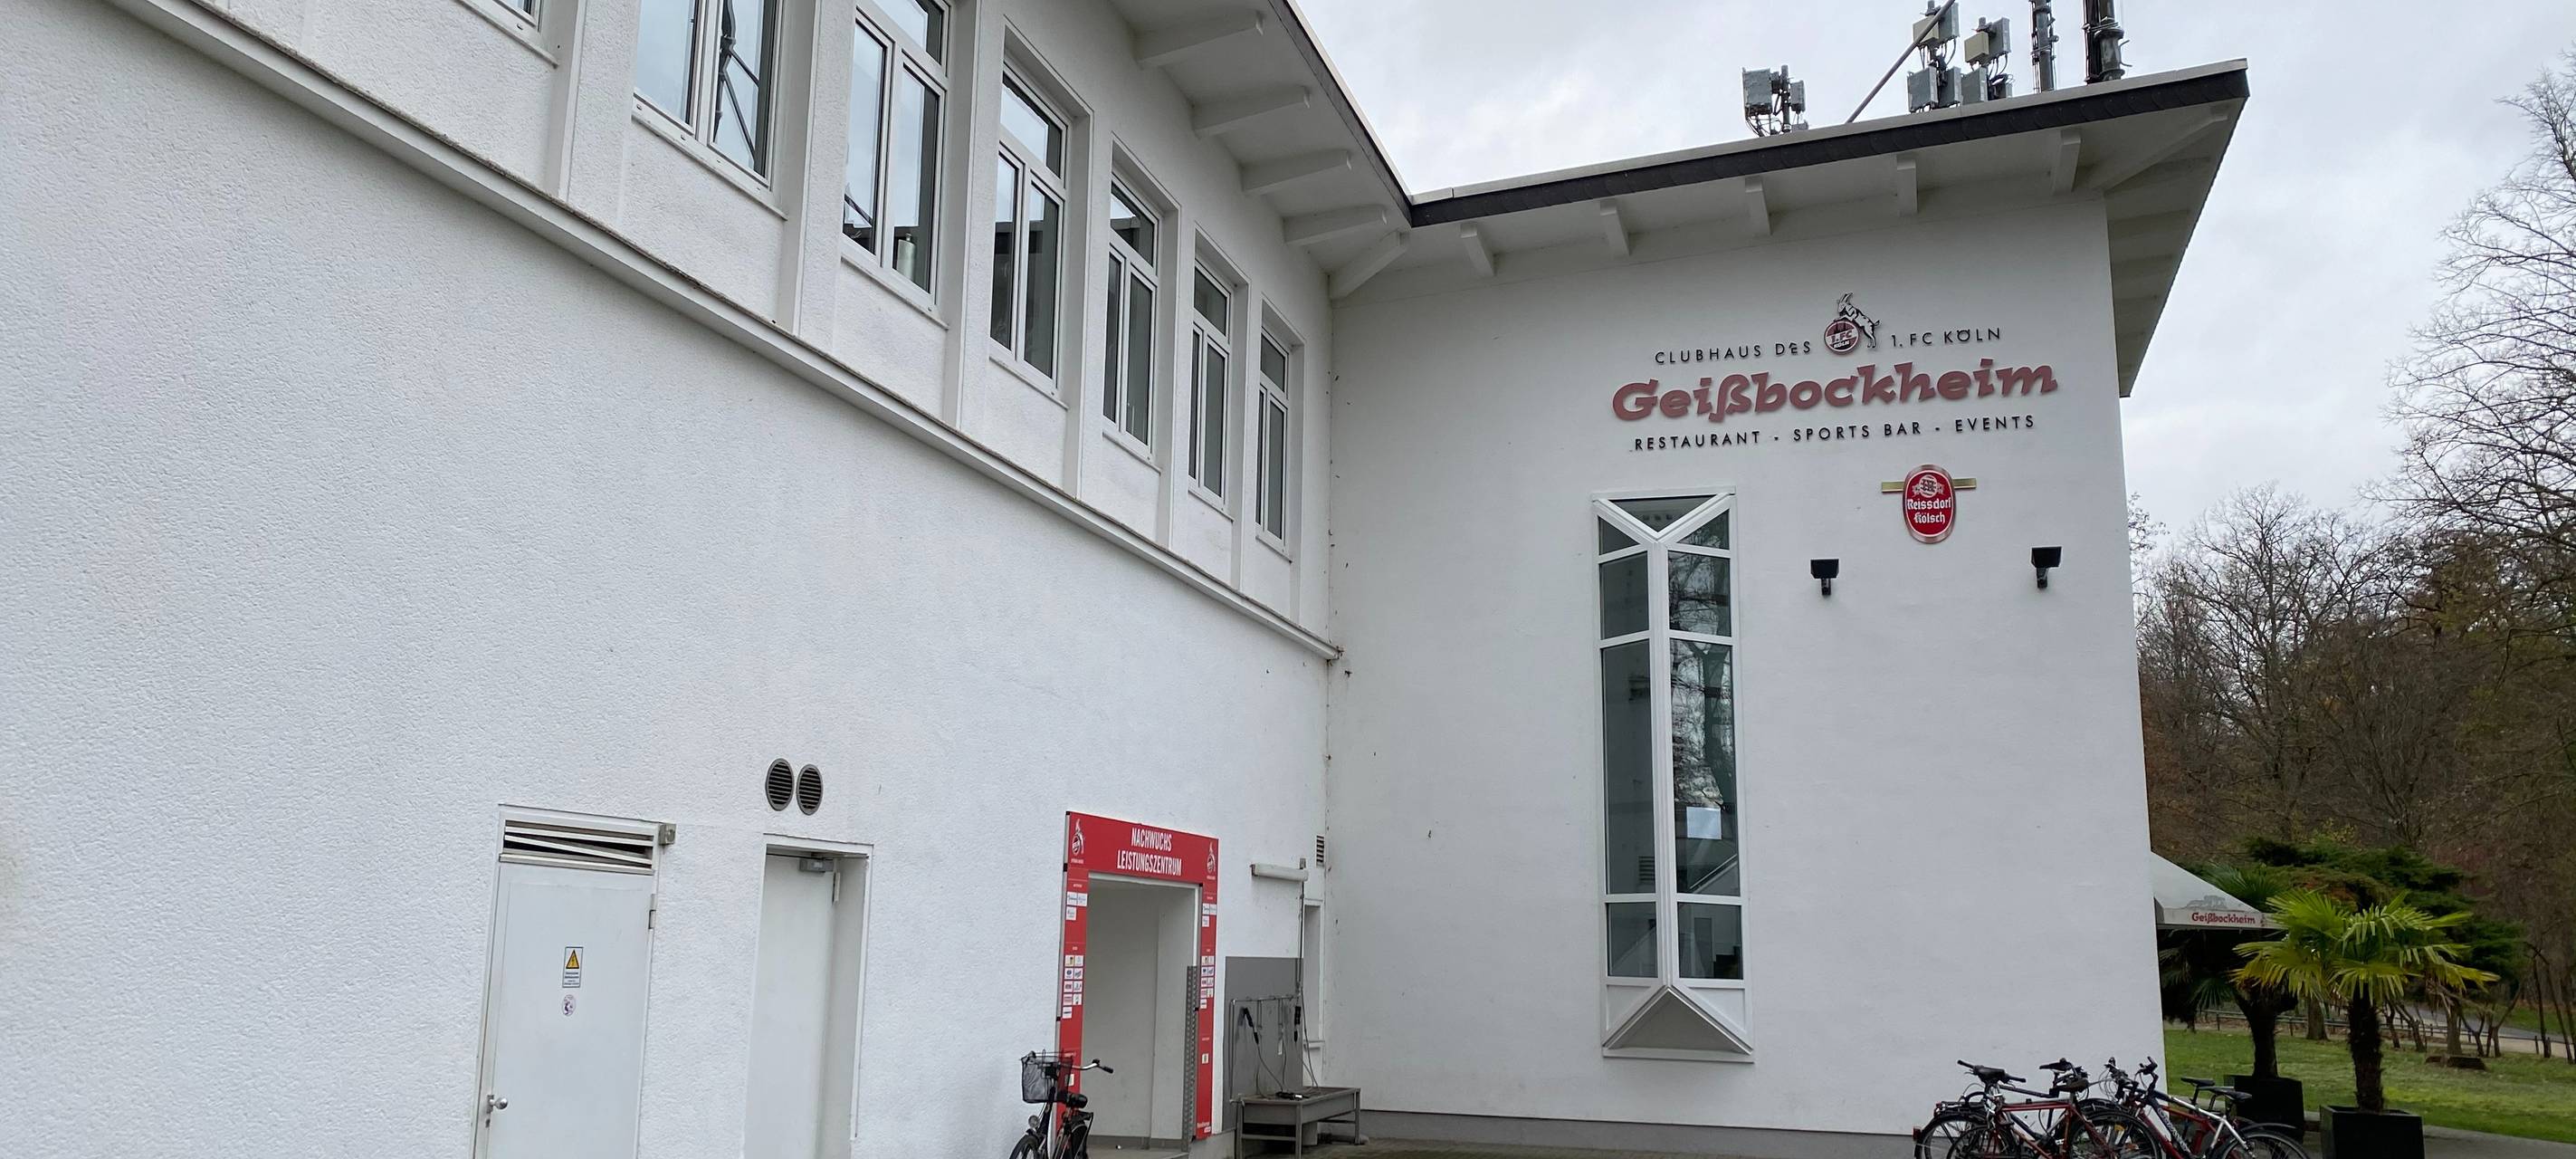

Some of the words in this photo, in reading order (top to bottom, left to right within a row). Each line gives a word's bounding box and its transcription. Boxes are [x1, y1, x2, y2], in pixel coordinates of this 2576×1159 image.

[1655, 345, 1761, 363] CLUBHAUS
[1775, 341, 1810, 356] DES
[1944, 327, 2000, 344] KÖLN
[1612, 358, 2059, 424] Geißbockheim
[1635, 430, 1760, 451] RESTAURANT
[1793, 425, 1870, 442] SPORTS
[1884, 421, 1921, 436] BAR
[1955, 415, 2034, 433] EVENTS
[1907, 496, 1951, 511] Reissdorf
[1913, 511, 1946, 524] Kölsch
[1131, 827, 1172, 852] NACHWUCHS
[1117, 850, 1182, 876] LEISTUNGSZENTRUM
[2191, 912, 2256, 924] Geißbockheim
